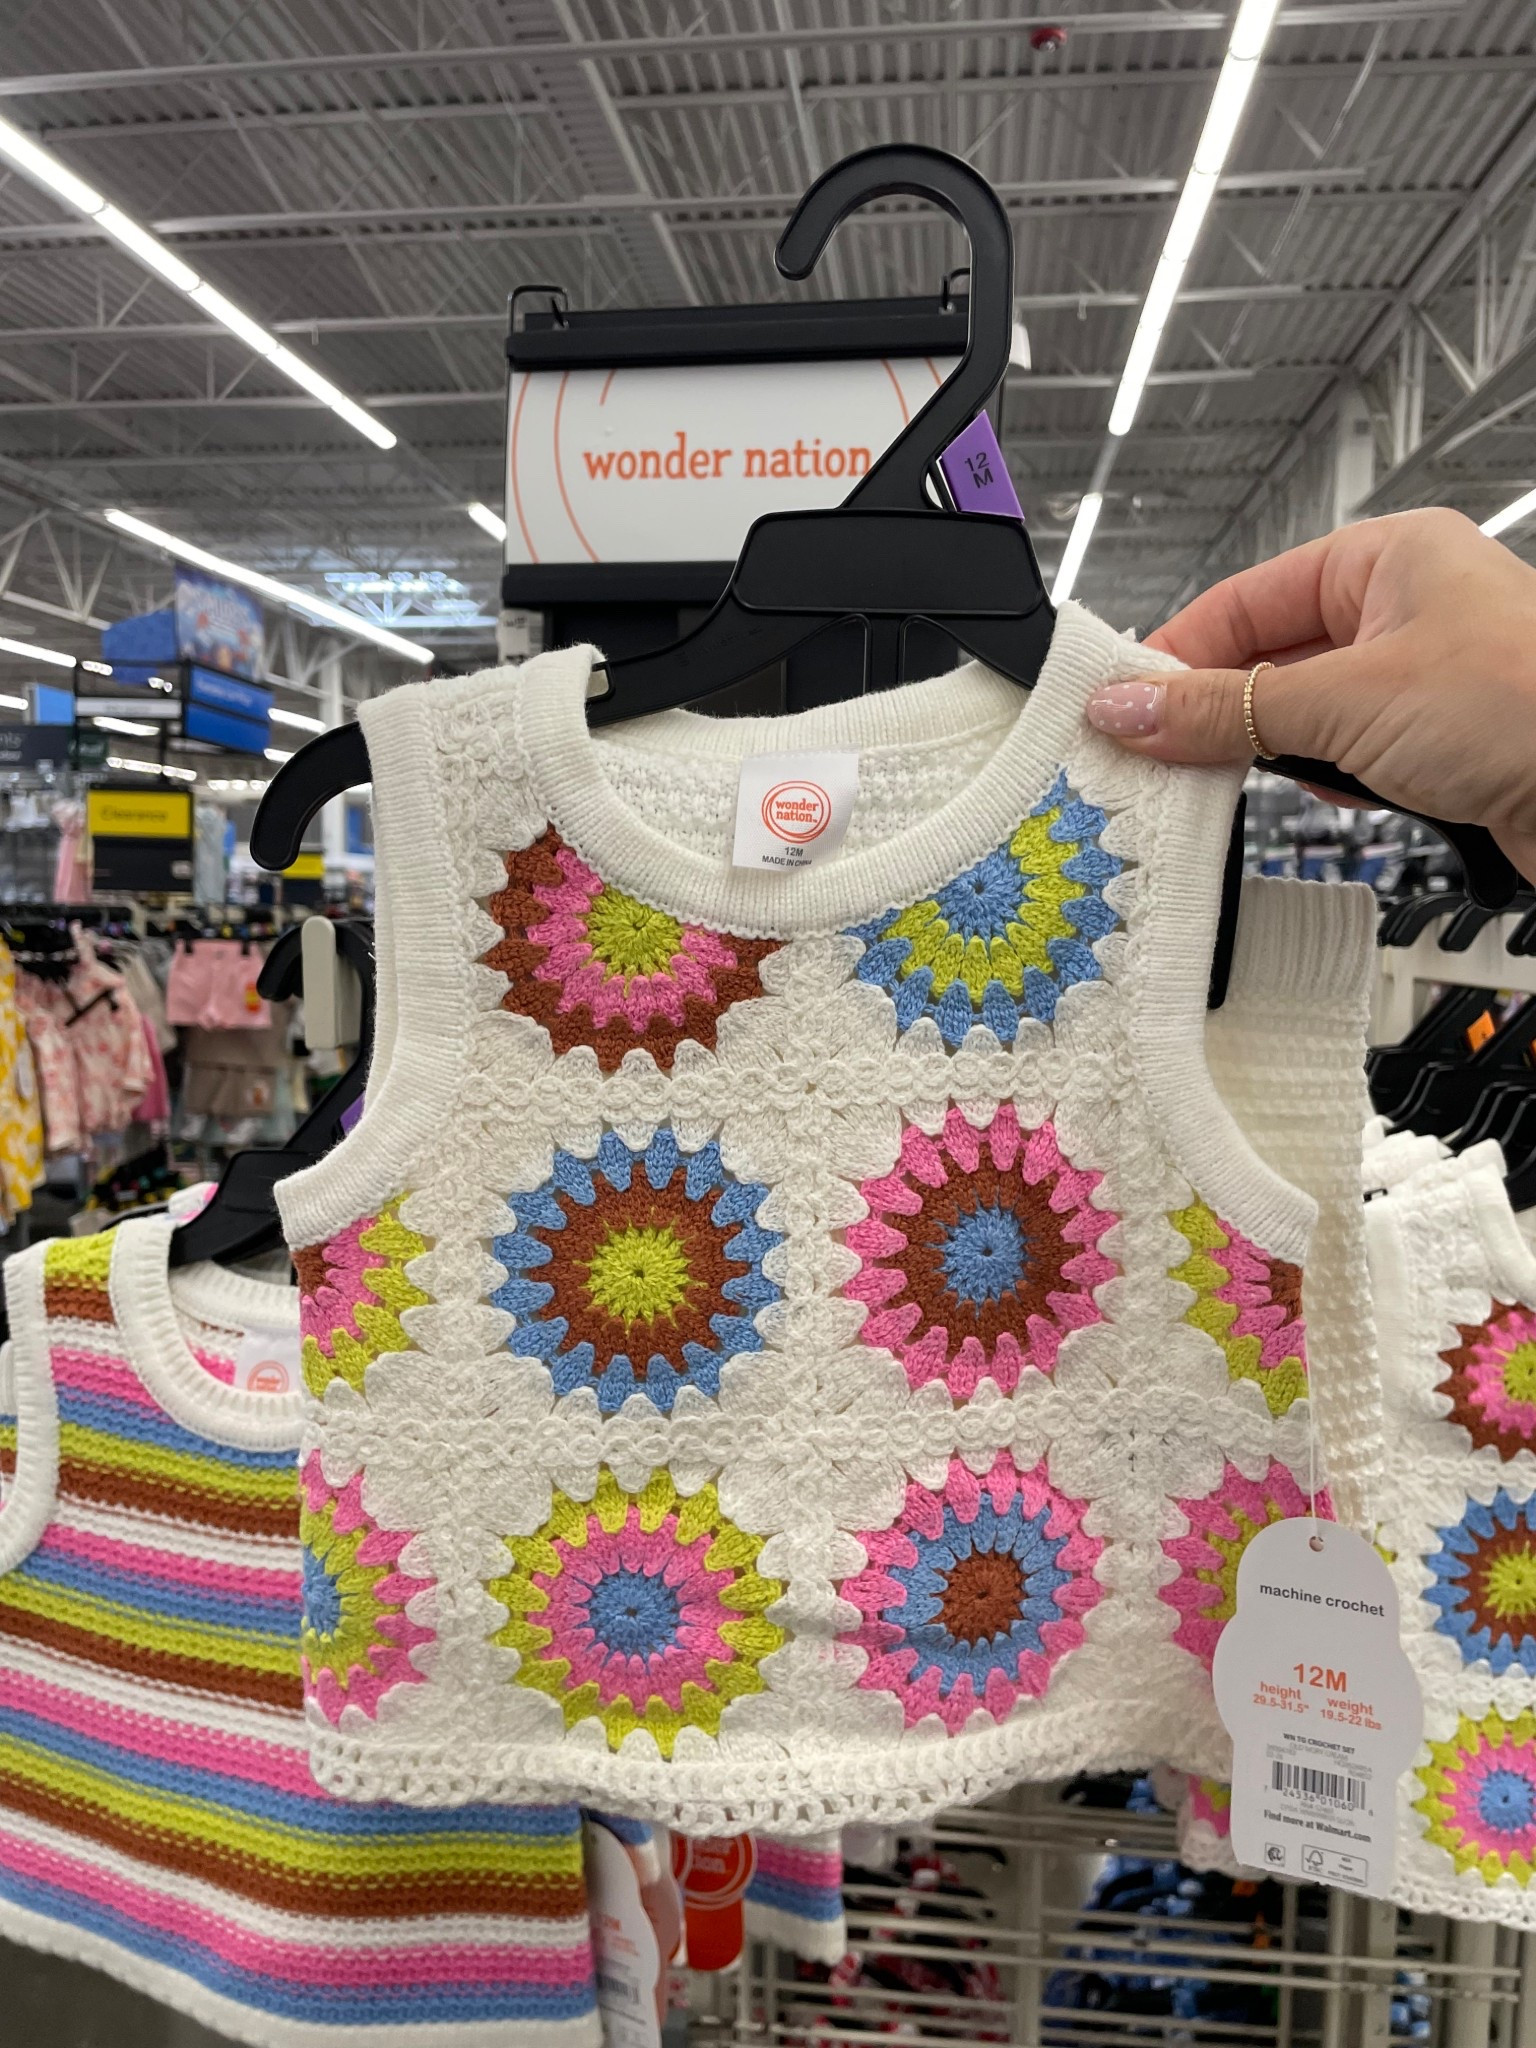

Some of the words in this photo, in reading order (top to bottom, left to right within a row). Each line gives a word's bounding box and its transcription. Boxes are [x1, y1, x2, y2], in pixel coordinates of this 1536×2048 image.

[583, 431, 733, 480] wonder
[743, 438, 872, 478] nation
[964, 452, 990, 472] 12
[973, 468, 994, 489] M
[775, 798, 819, 812] wonder
[761, 855, 786, 866] MADE
[785, 858, 795, 867] IN
[785, 846, 804, 857] 12M
[1259, 1584, 1322, 1605] machine
[1325, 1596, 1385, 1617] crochet
[1293, 1663, 1347, 1693] 12M
[1260, 1681, 1302, 1700] height
[1327, 1697, 1374, 1716] weight
[1320, 1708, 1362, 1726] 19.5-22
[1364, 1718, 1383, 1730] lbs
[1307, 1738, 1341, 1751] CROCHET
[1342, 1745, 1355, 1754] SET
[1264, 1809, 1282, 1822] Find
[1282, 1815, 1304, 1827] more
[1305, 1821, 1315, 1829] at
[1316, 1821, 1372, 1843] Walmart.com
